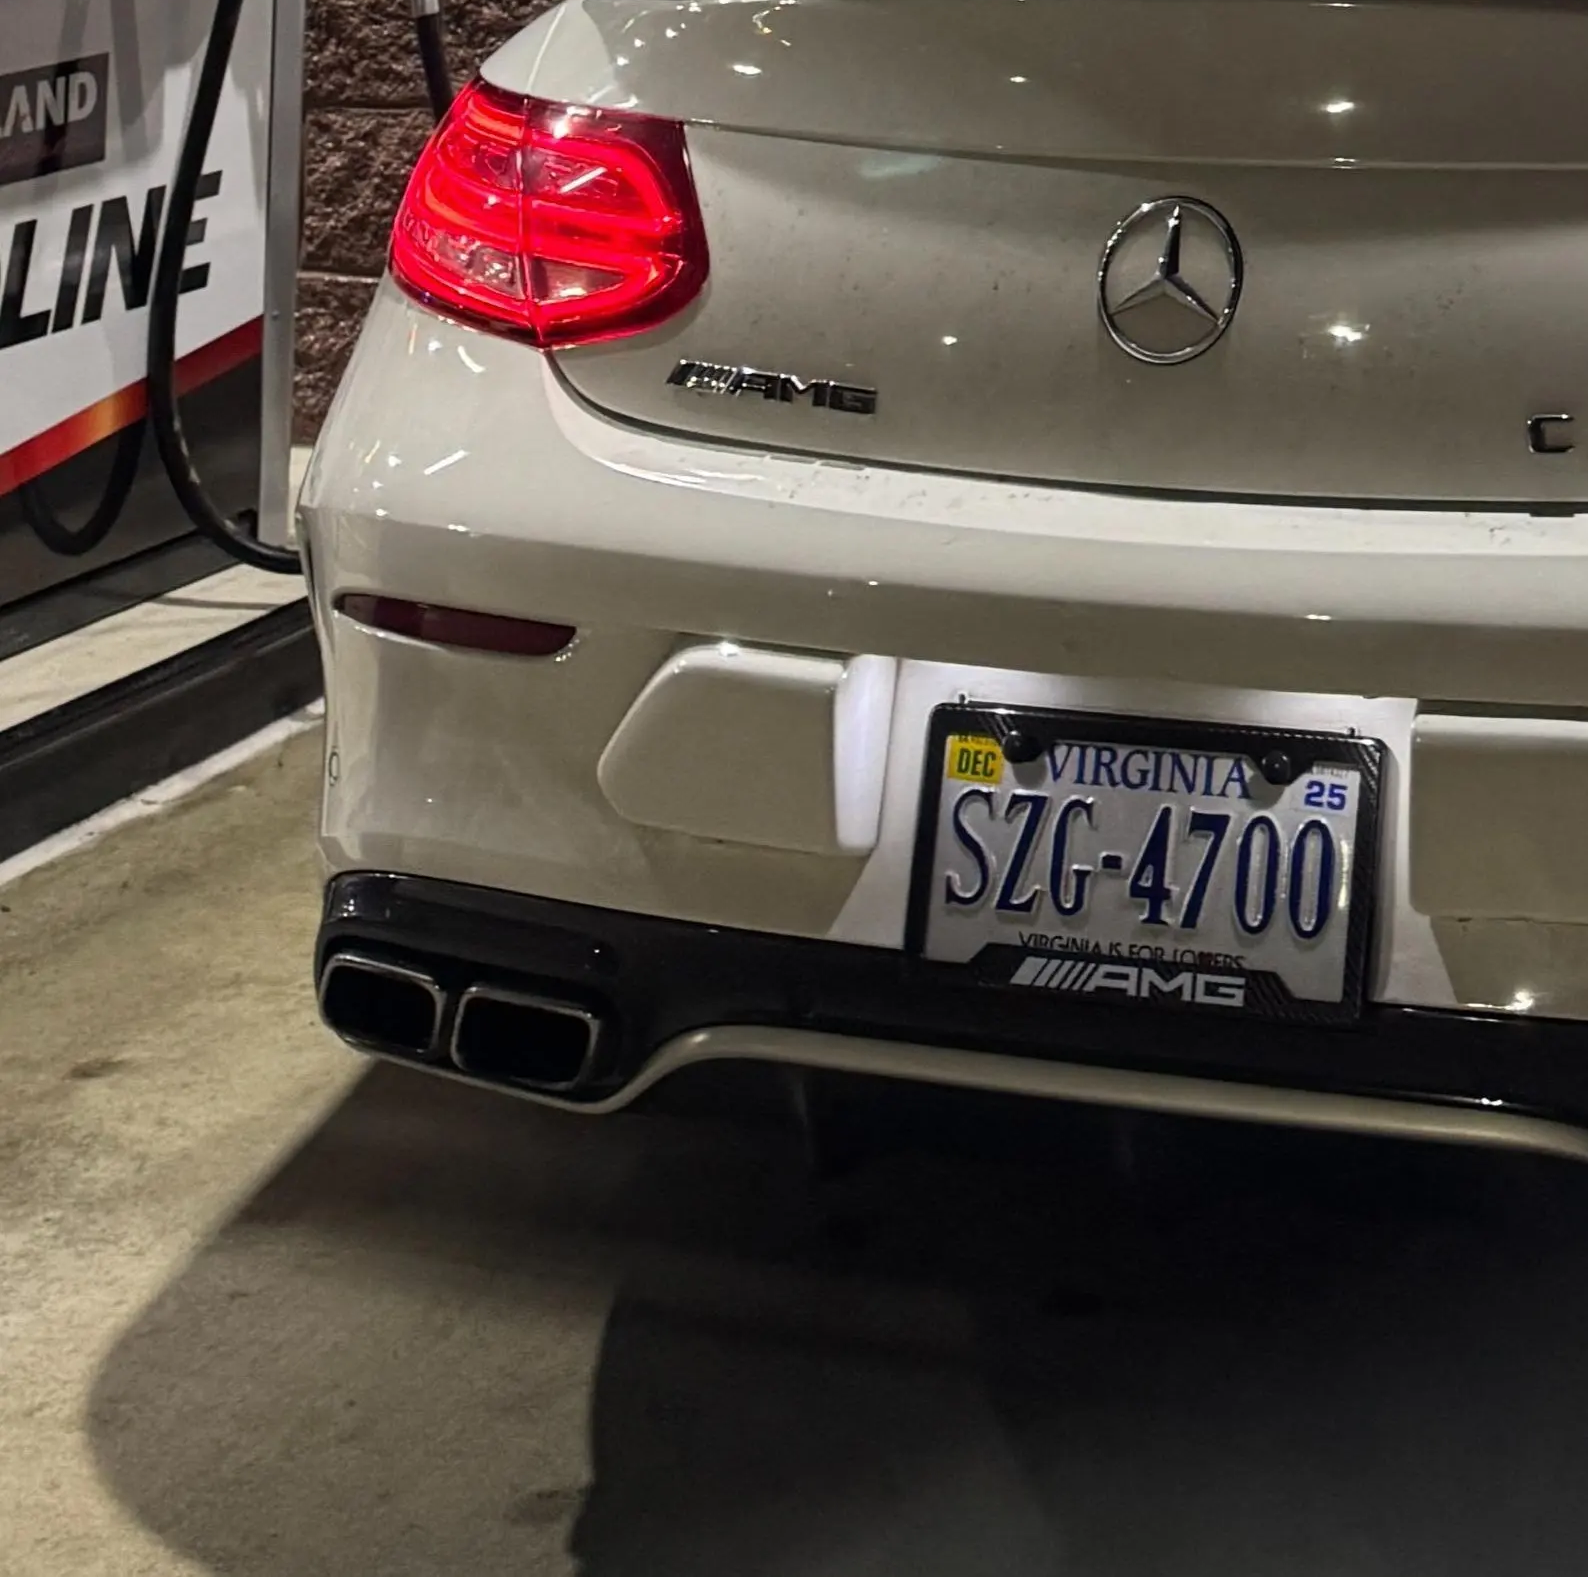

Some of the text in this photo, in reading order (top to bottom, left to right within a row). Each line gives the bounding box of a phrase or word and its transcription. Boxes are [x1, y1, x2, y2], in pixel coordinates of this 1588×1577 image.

[0, 71, 98, 139] AND
[1527, 413, 1575, 454] C
[957, 748, 996, 778] DEC
[1047, 743, 1251, 800] VIRGINIA
[1304, 779, 1348, 811] 25
[944, 790, 1336, 941] SZG-4700
